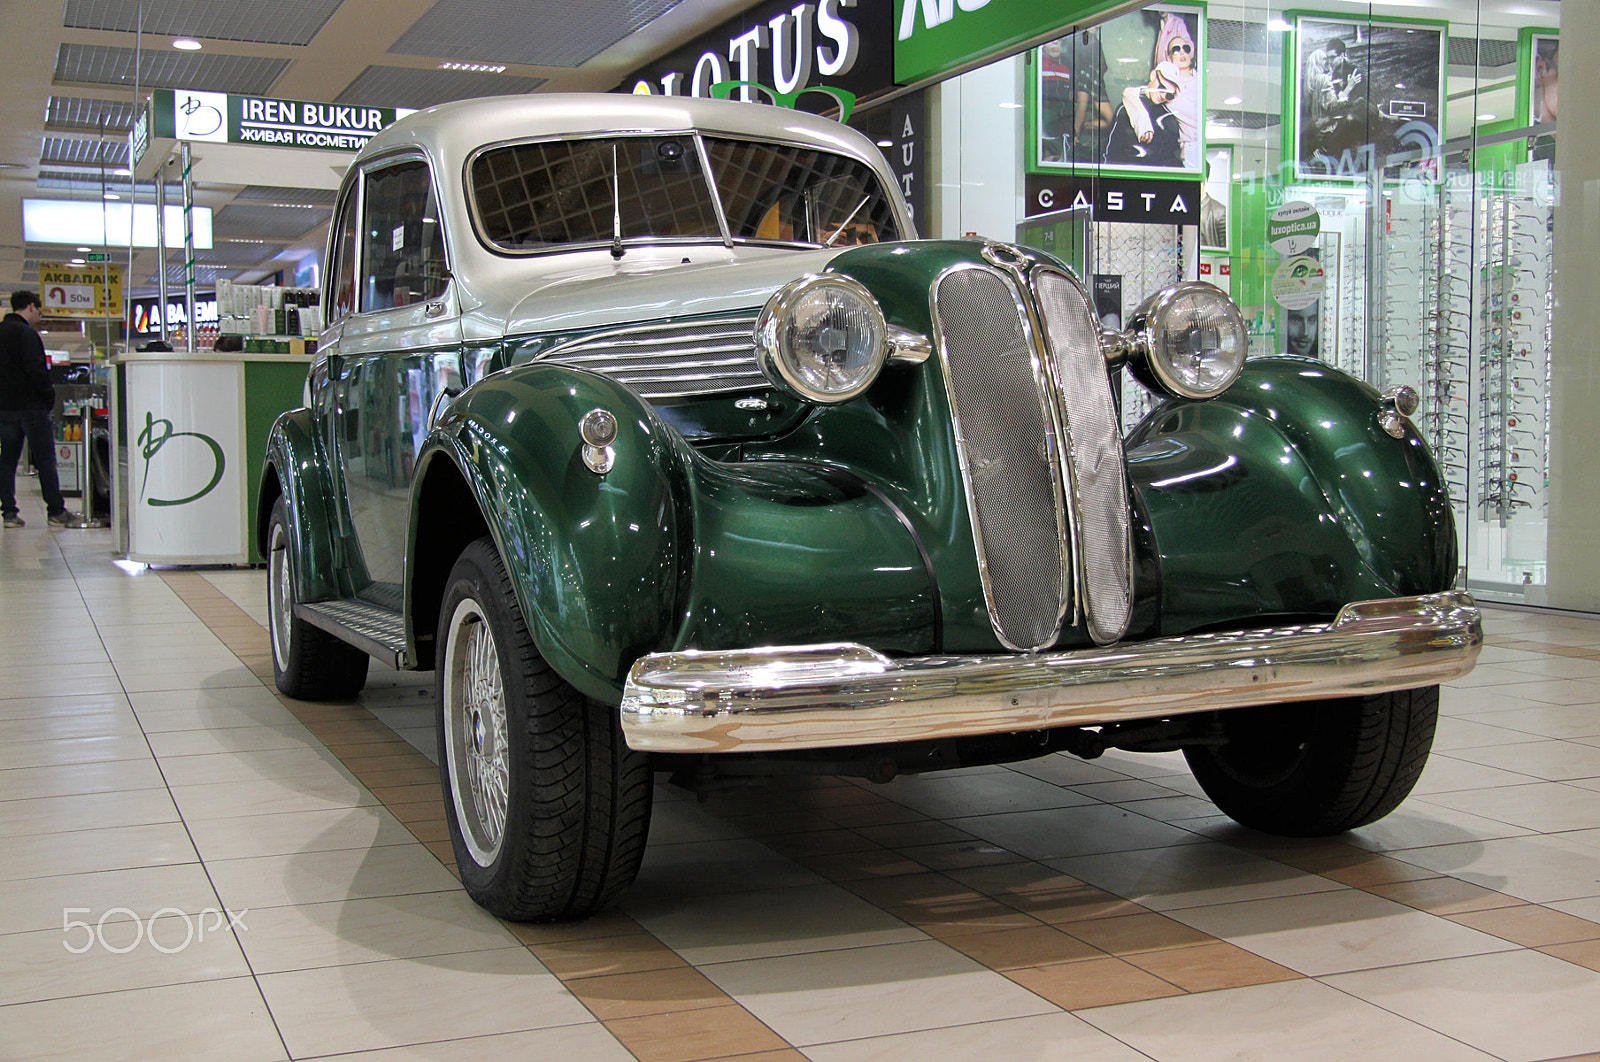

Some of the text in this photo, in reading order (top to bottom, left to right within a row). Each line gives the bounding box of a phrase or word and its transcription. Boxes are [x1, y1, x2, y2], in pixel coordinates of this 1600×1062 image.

[242, 99, 383, 130] IREN BUKUR
[240, 128, 369, 150] ЖИВАЯ КОСМЕТИ
[1038, 188, 1188, 213] CASTA
[1271, 221, 1317, 236] luxoptica.ua
[70, 293, 90, 303] 50м
